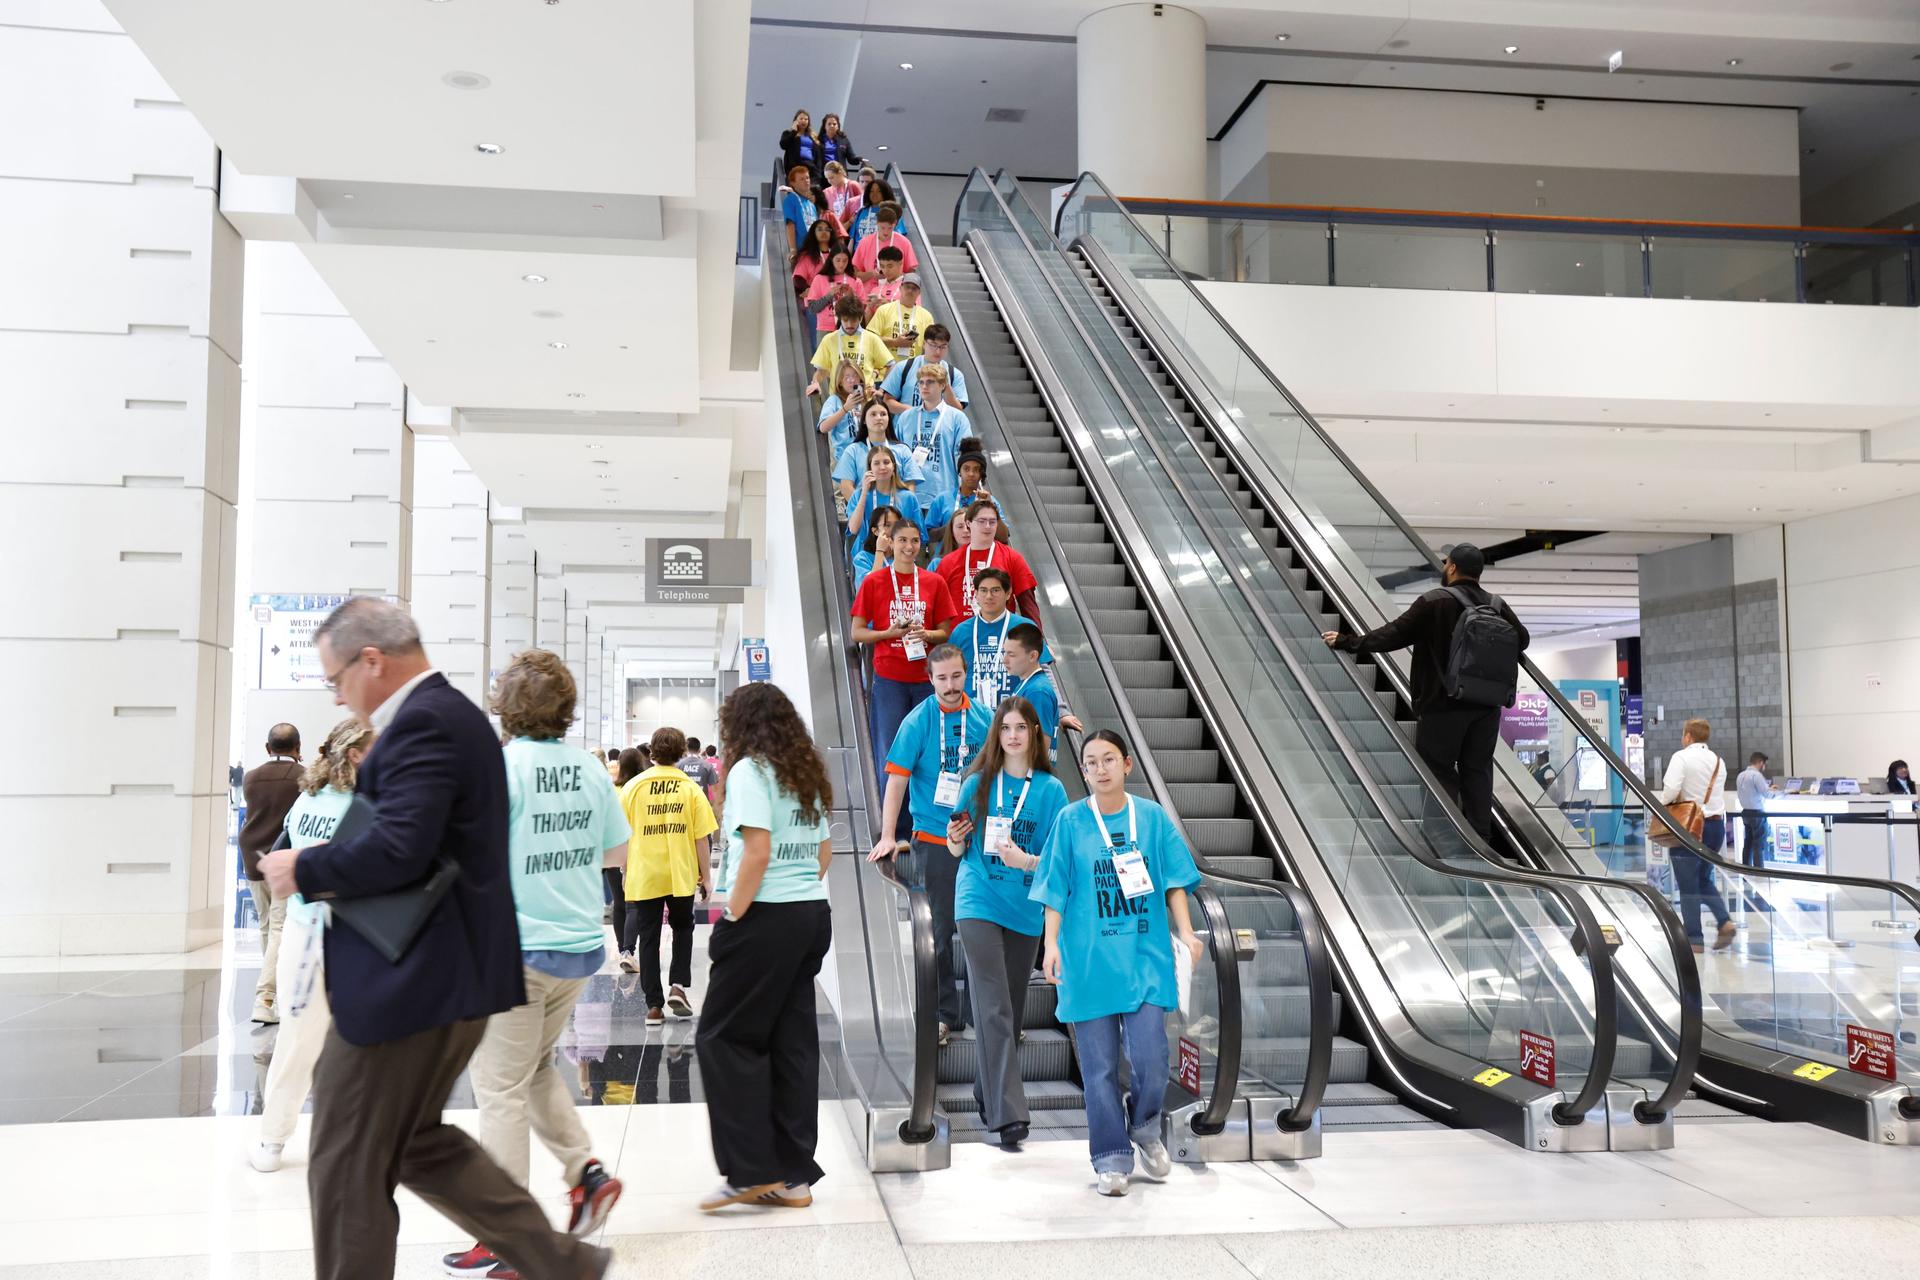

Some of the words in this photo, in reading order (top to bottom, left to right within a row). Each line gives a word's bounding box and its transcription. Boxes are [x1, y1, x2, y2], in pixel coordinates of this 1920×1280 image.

[657, 590, 710, 601] Telephone
[290, 619, 312, 627] WEST
[289, 640, 313, 648] ATTEN
[1518, 698, 1548, 710] pkb
[683, 764, 700, 773] RACE
[536, 765, 581, 793] RACE
[650, 780, 681, 795] RACE
[297, 813, 337, 840] RACE
[1101, 929, 1119, 937] SICK
